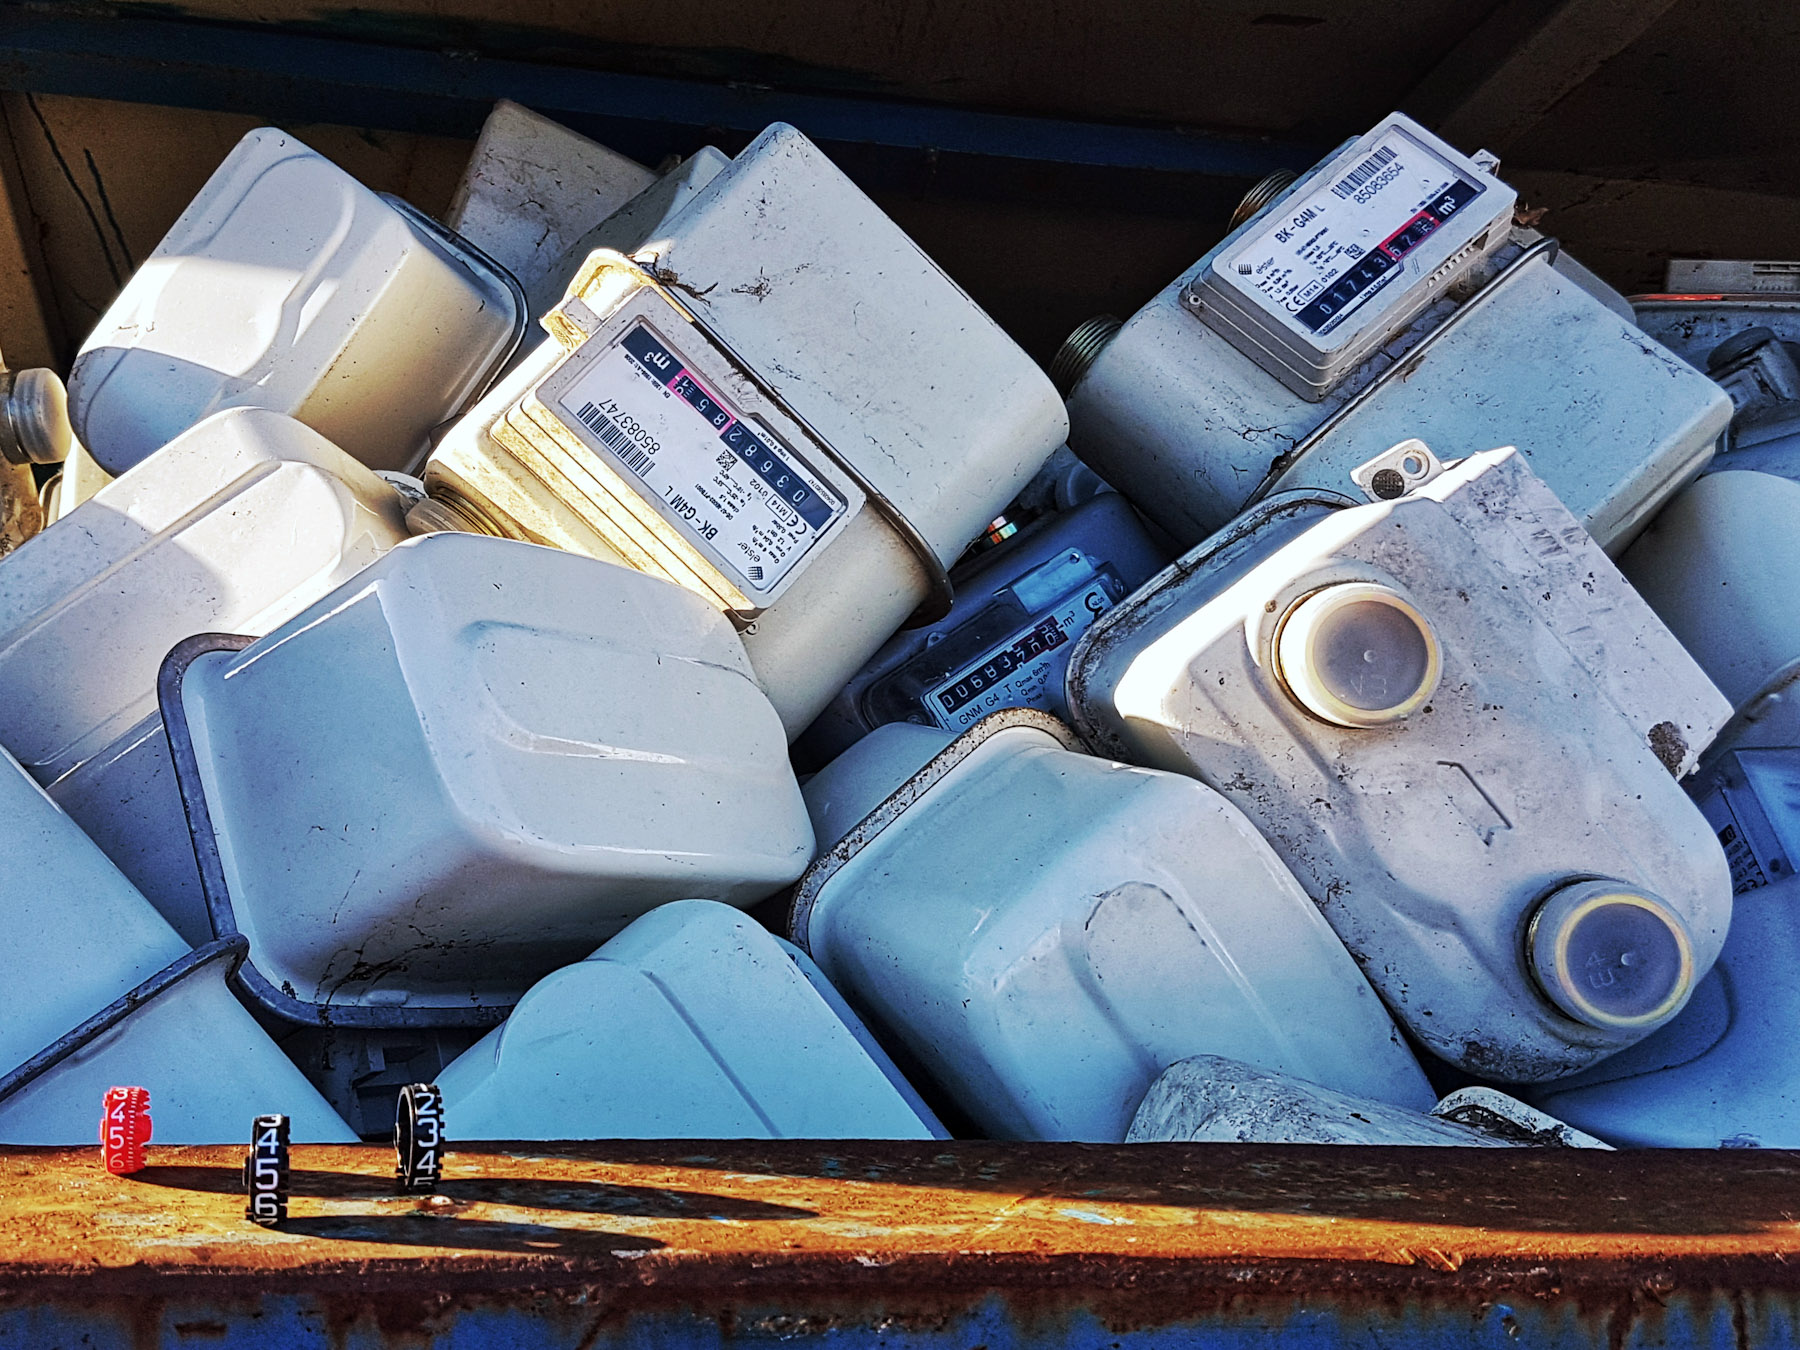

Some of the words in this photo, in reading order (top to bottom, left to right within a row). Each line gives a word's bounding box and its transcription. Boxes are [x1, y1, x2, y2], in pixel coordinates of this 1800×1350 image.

[1353, 162, 1404, 204] 85083654
[1303, 284, 1319, 297] M14
[1321, 268, 1338, 283] 0102
[598, 399, 660, 455] 85083747
[665, 485, 673, 496] L
[749, 478, 768, 497] 0102
[669, 494, 718, 541] BK-G4M
[771, 500, 788, 516] M14
[786, 514, 807, 535] CE
[737, 542, 761, 562] elster
[959, 704, 984, 725] GNM
[985, 693, 1000, 707] G4
[1003, 683, 1012, 693] T
